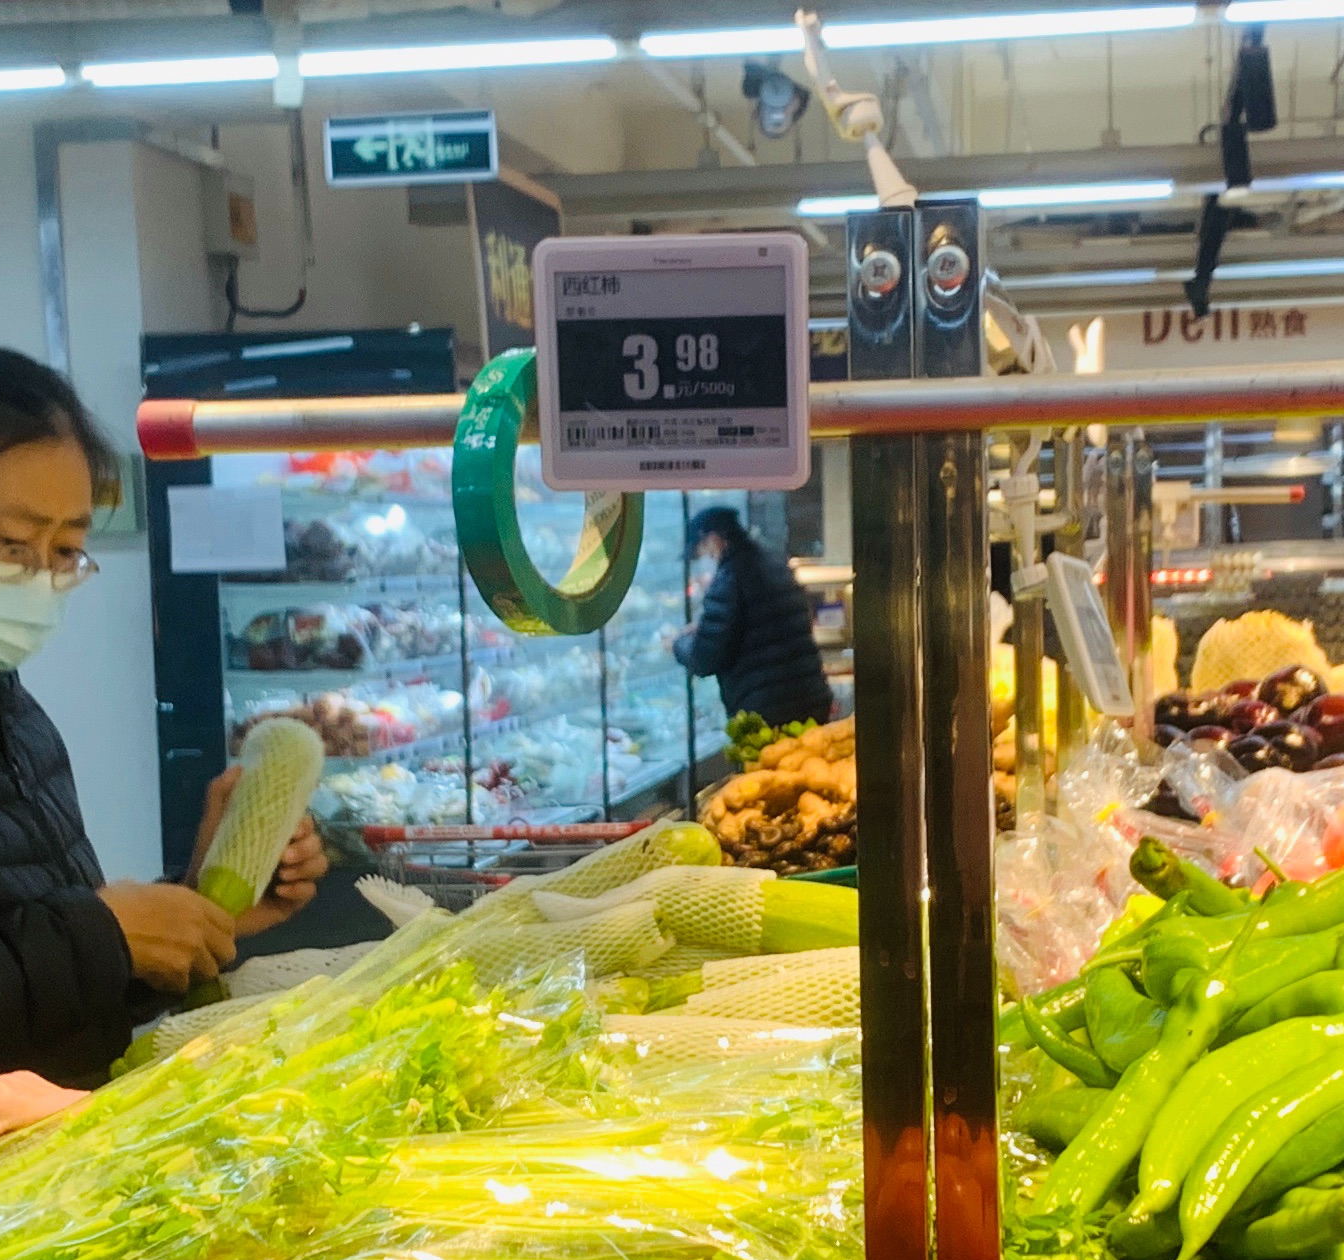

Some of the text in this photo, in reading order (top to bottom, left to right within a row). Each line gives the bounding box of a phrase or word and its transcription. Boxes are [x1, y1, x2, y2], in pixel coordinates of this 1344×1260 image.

[562, 275, 621, 296] 西红柿
[1249, 307, 1307, 338] 熟食
